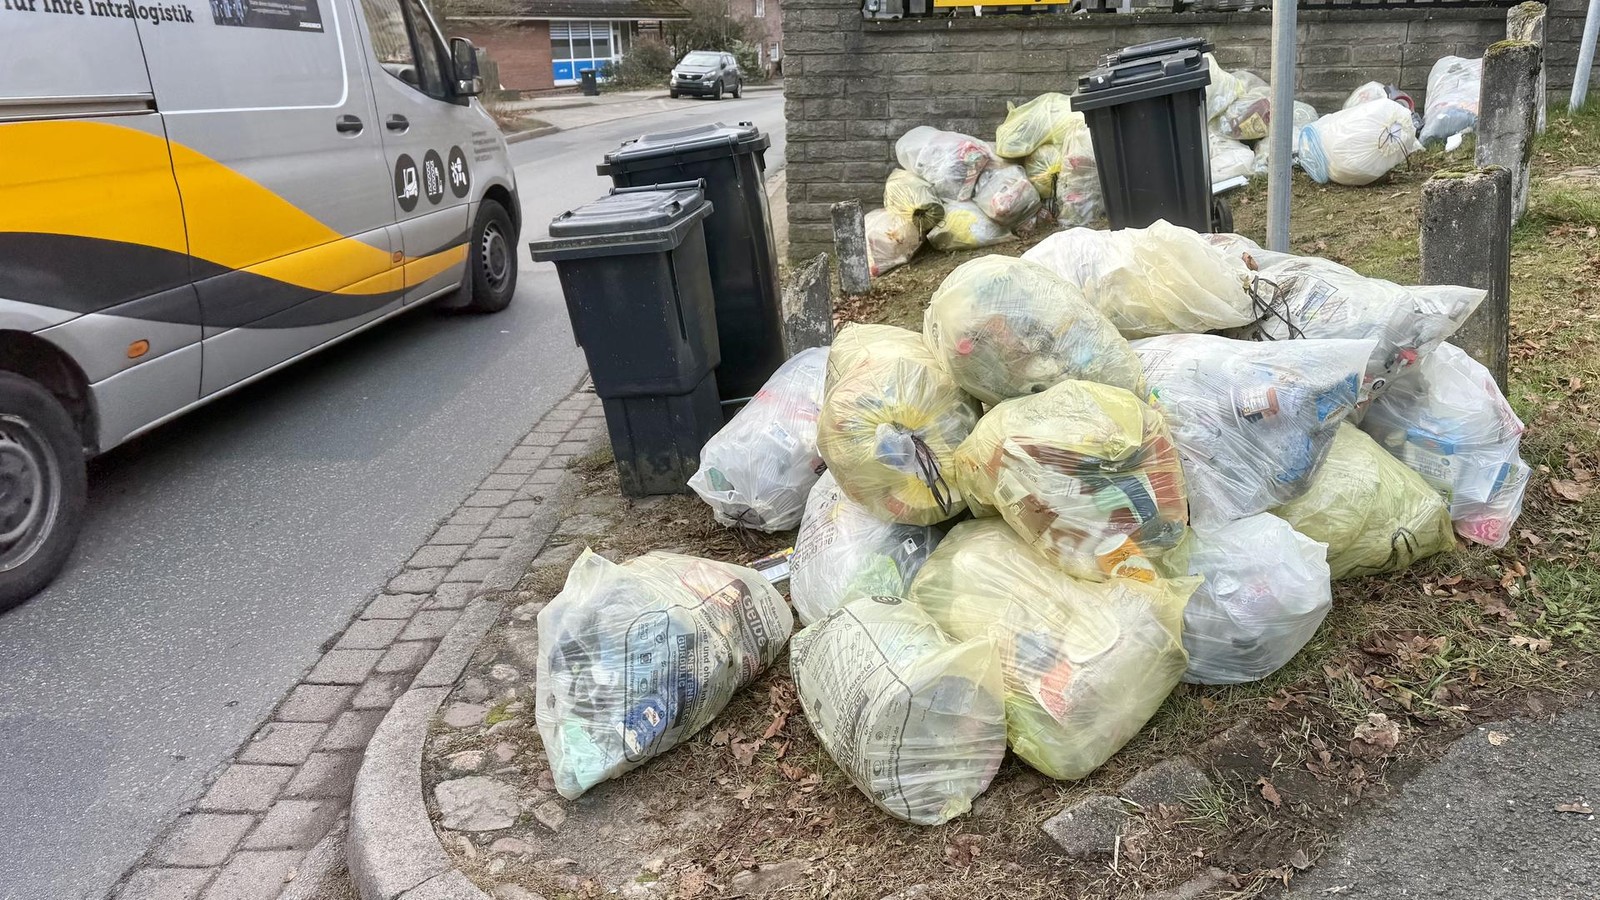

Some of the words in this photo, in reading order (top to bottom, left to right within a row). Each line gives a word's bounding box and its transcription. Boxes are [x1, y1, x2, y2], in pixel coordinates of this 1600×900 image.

[44, 0, 85, 15] Ihre
[90, 0, 194, 25] Intralogistik
[742, 594, 767, 648] Gelbe
[677, 636, 688, 688] GURDULIC
[703, 666, 711, 687] ohne
